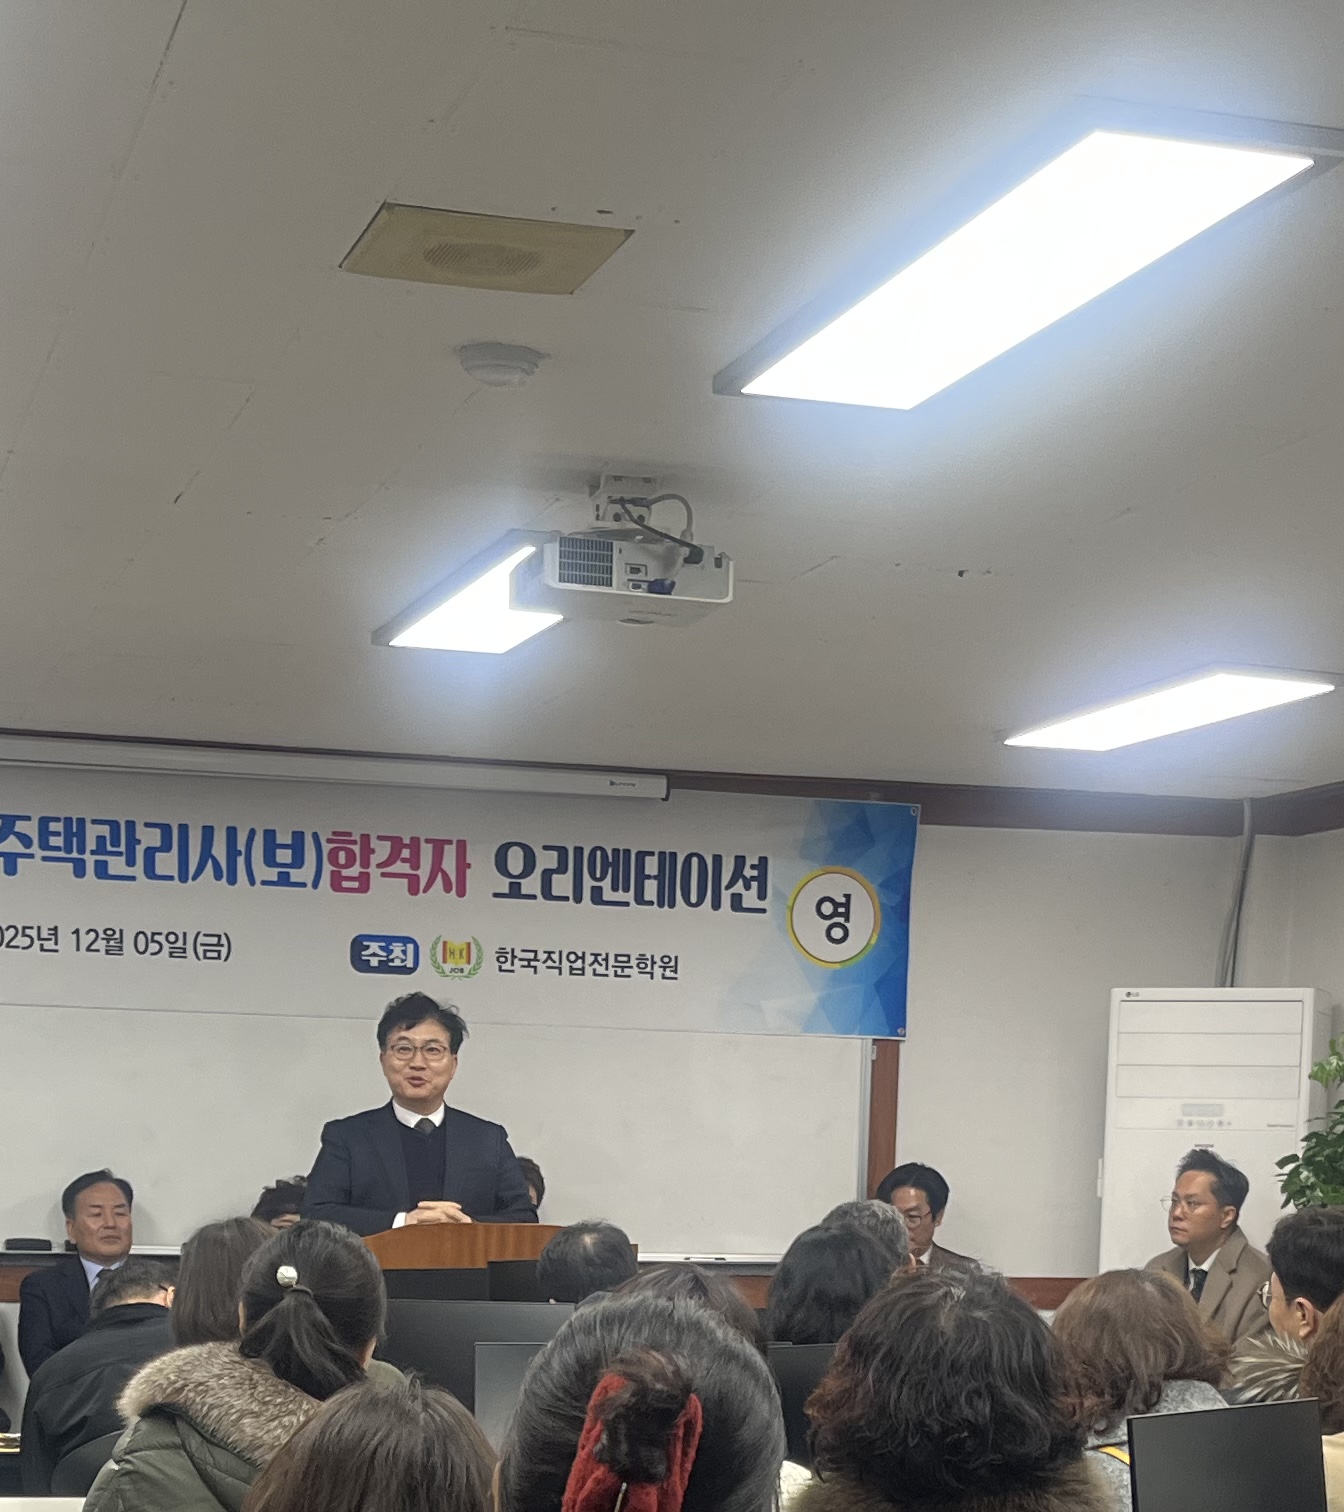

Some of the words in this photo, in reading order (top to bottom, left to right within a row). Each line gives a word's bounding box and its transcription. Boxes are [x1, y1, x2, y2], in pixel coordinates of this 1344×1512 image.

[492, 841, 768, 914] 오리엔테이션
[815, 893, 852, 945] 영
[71, 927, 125, 956] 12월
[133, 930, 232, 962] 05일(금)
[360, 941, 414, 969] 주최
[495, 946, 680, 980] 한국직업전문학원
